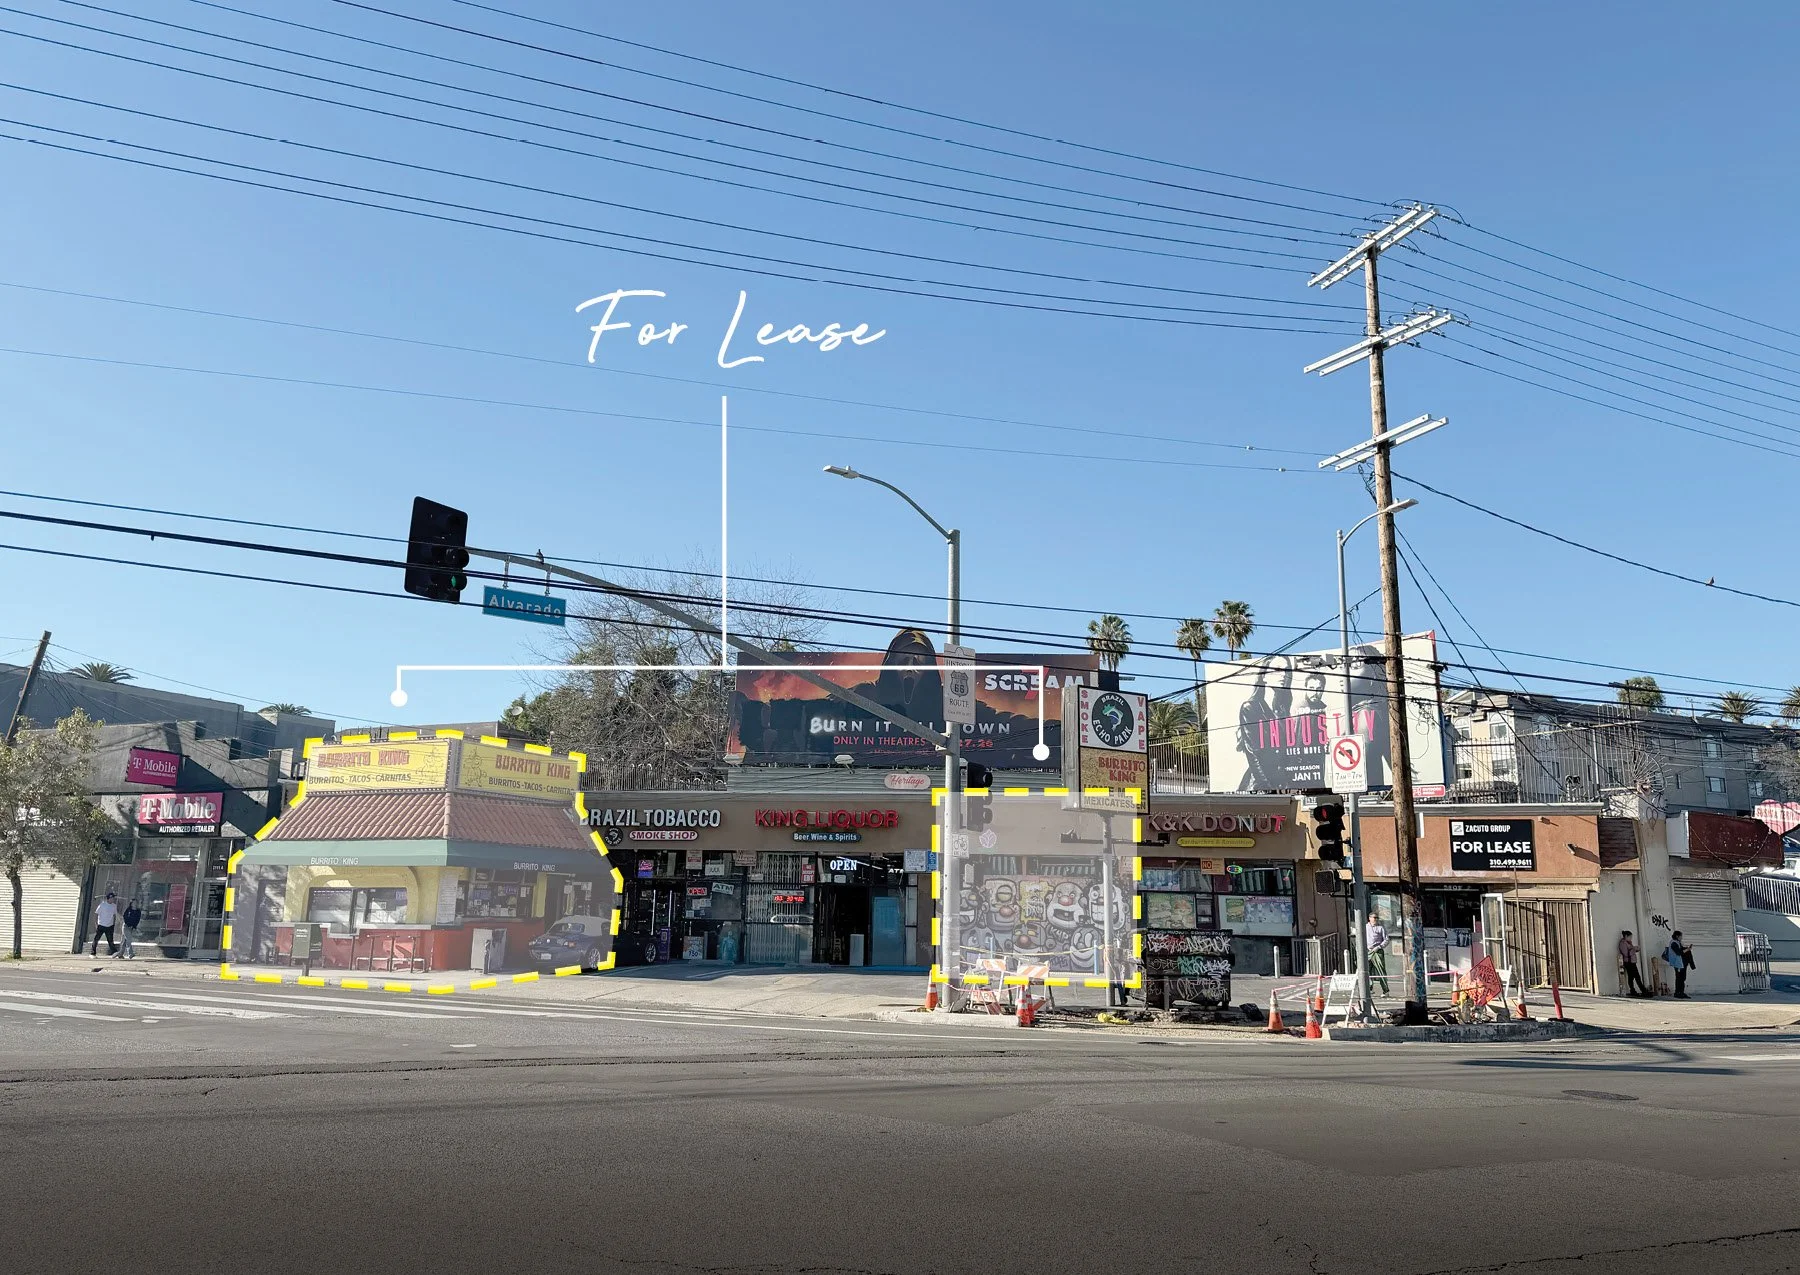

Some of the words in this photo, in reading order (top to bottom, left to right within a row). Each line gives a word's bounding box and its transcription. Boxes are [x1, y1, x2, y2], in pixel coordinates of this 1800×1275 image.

[488, 594, 562, 618] Alvarado
[954, 684, 965, 694] 66
[949, 699, 969, 708] ROUTE
[1101, 695, 1124, 706] BRAZIL
[1080, 689, 1089, 744] SMOKE
[810, 717, 863, 734] BURN
[874, 721, 892, 732] IT
[1137, 697, 1145, 750] VAPE
[1092, 719, 1111, 742] ECHO
[1114, 726, 1133, 745] PARK
[833, 736, 860, 745] ONLY
[863, 736, 875, 745] IN
[878, 737, 927, 746] THEATRES
[1286, 748, 1301, 756] LIES
[1304, 746, 1321, 755] MOVE
[378, 749, 410, 766] KING
[495, 754, 541, 775] BURRITO
[546, 762, 571, 779] KING
[1098, 756, 1146, 773] BURRITO
[308, 775, 345, 785] BURRITOS
[349, 774, 371, 783] TACOS
[375, 773, 412, 782] CARNITAS
[488, 776, 520, 789] BURRITOS
[890, 775, 926, 788] Heritage
[1109, 770, 1137, 784] KING
[1292, 773, 1311, 782] JAN
[1313, 772, 1321, 781] 11
[643, 809, 722, 827] TOBACCO
[755, 809, 809, 828] KING
[815, 809, 899, 829] LIQUOR
[1149, 813, 1195, 832] K&K
[1203, 814, 1287, 833] DONUT
[159, 825, 190, 833] AUTHORIZED
[1465, 824, 1489, 833] ZACUTO
[1490, 824, 1511, 833] GROUP
[631, 831, 666, 840] SMOKE
[668, 831, 696, 840] SHOP
[835, 833, 857, 842] Spirits
[1452, 841, 1483, 854] FOR
[1486, 841, 1532, 854] LEASE
[310, 857, 339, 865] BURRITO
[342, 857, 359, 865] KING
[513, 862, 539, 871] BURRITO
[541, 864, 556, 872] KING
[829, 859, 857, 871] OPEN
[1489, 858, 1532, 866] 310.499.9611
[713, 883, 733, 893] ATM
